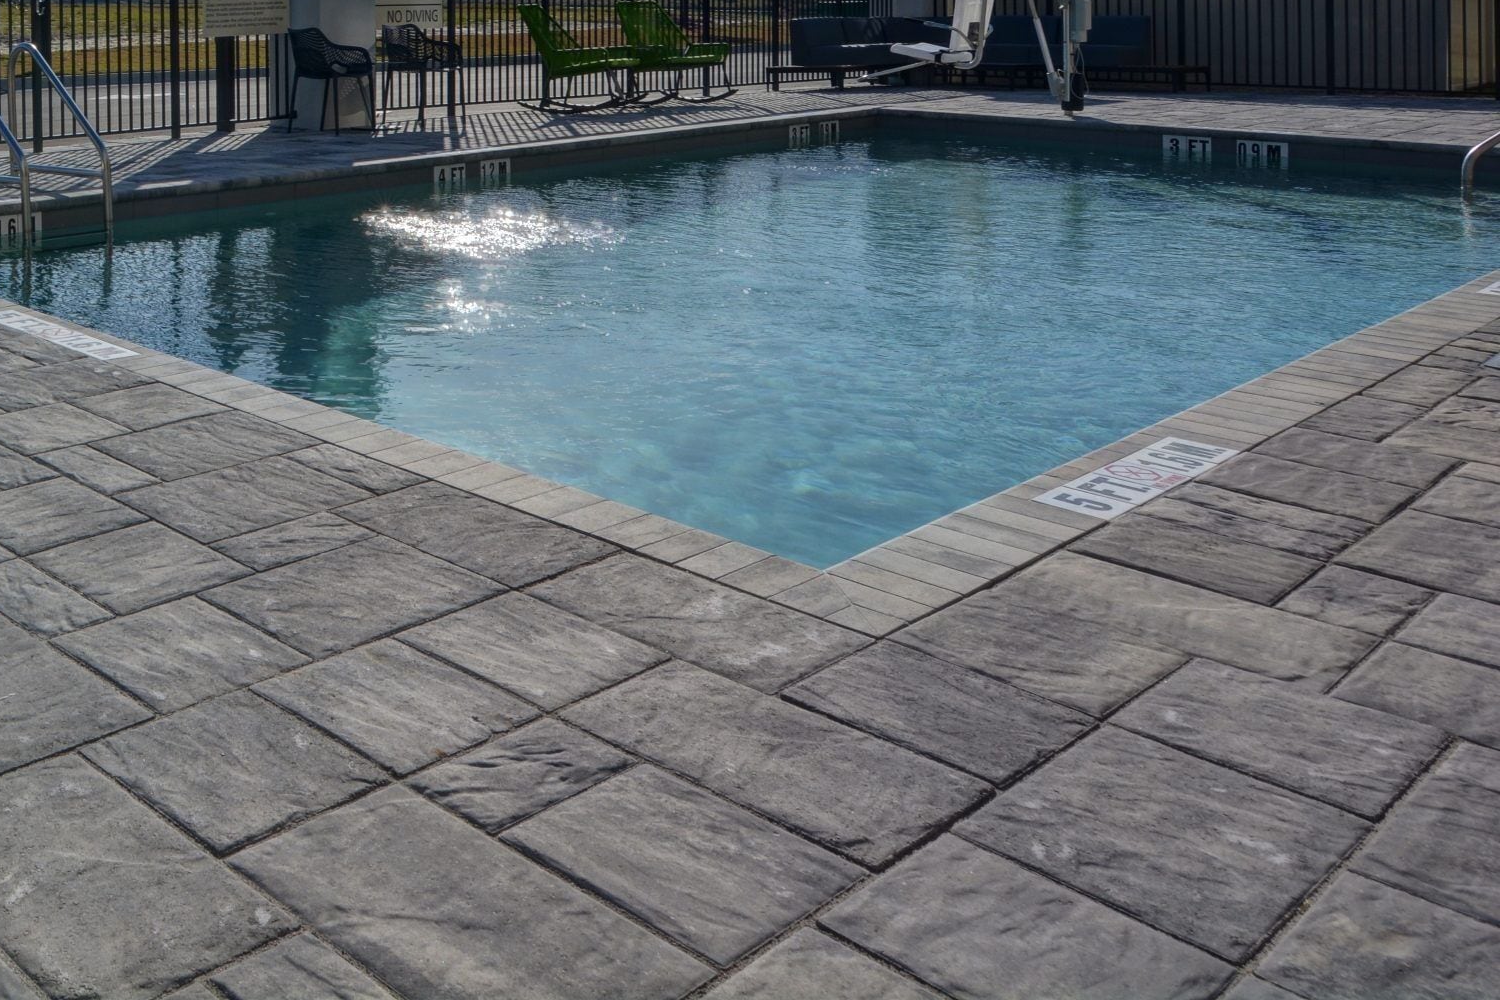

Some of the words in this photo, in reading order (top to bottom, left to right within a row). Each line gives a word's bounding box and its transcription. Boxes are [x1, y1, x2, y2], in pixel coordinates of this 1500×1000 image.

[387, 10, 402, 22] NO
[406, 10, 438, 22] DIVING
[1188, 140, 1209, 156] FT
[1267, 144, 1282, 158] M
[451, 166, 464, 182] FT
[1052, 492, 1114, 512] 5
